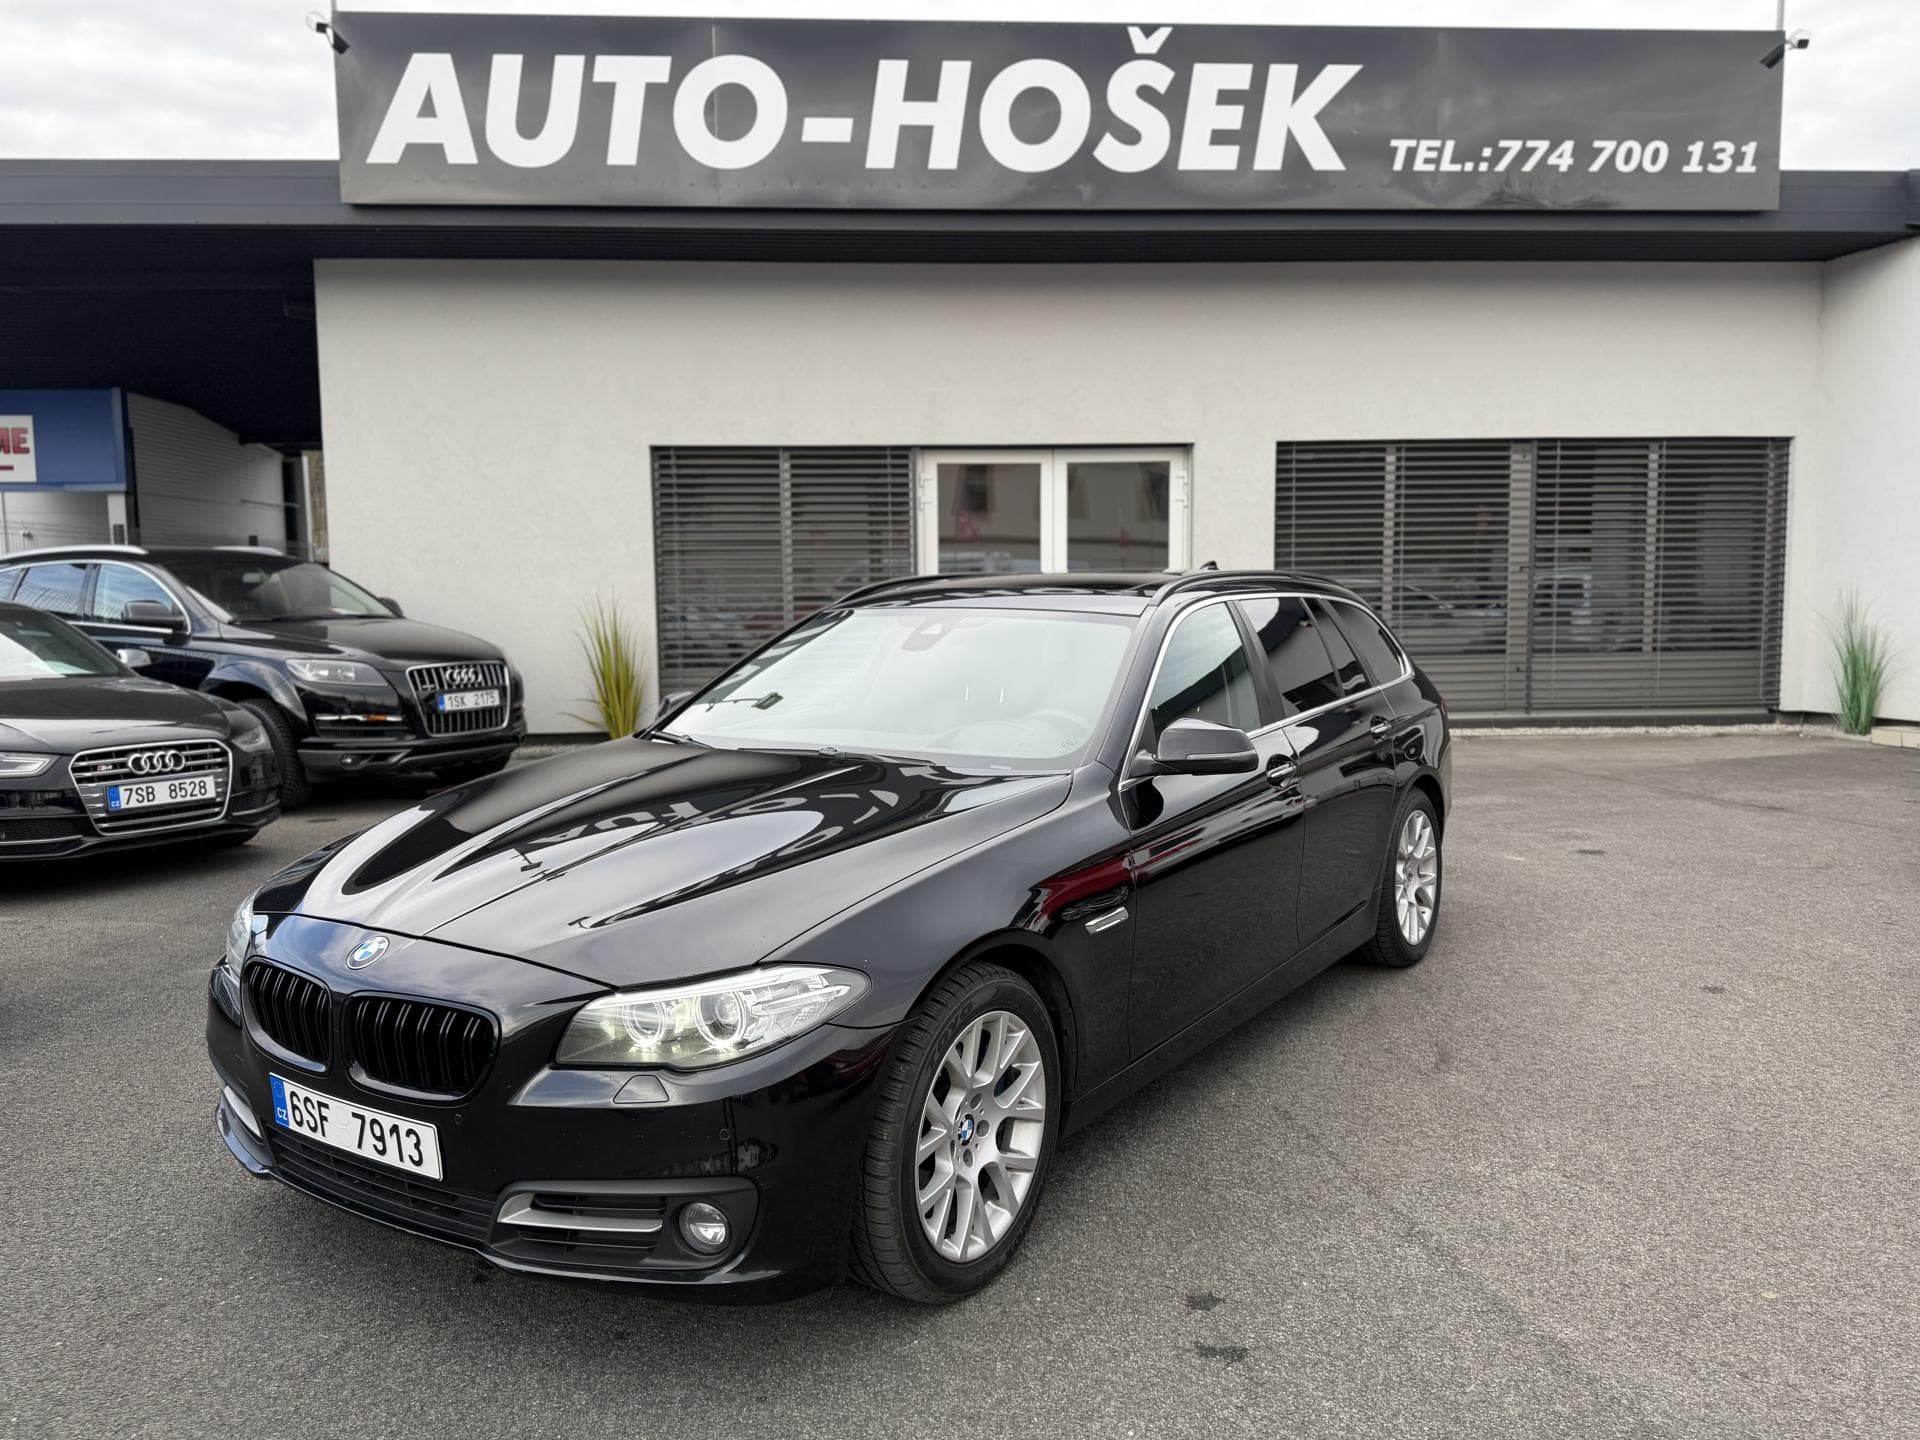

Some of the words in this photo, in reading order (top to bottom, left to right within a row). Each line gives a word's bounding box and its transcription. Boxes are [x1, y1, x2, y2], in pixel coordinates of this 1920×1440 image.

[366, 27, 1362, 172] AUTO-HOŠEK
[1588, 140, 1669, 173] 700
[1682, 141, 1758, 174] 131
[448, 695, 466, 708] 1SK
[474, 690, 496, 705] 2175
[124, 786, 156, 805] 7SB
[168, 780, 207, 799] 8528
[277, 1107, 288, 1121] CZ
[289, 1091, 330, 1137] 6SF
[351, 1112, 424, 1167] 7913
